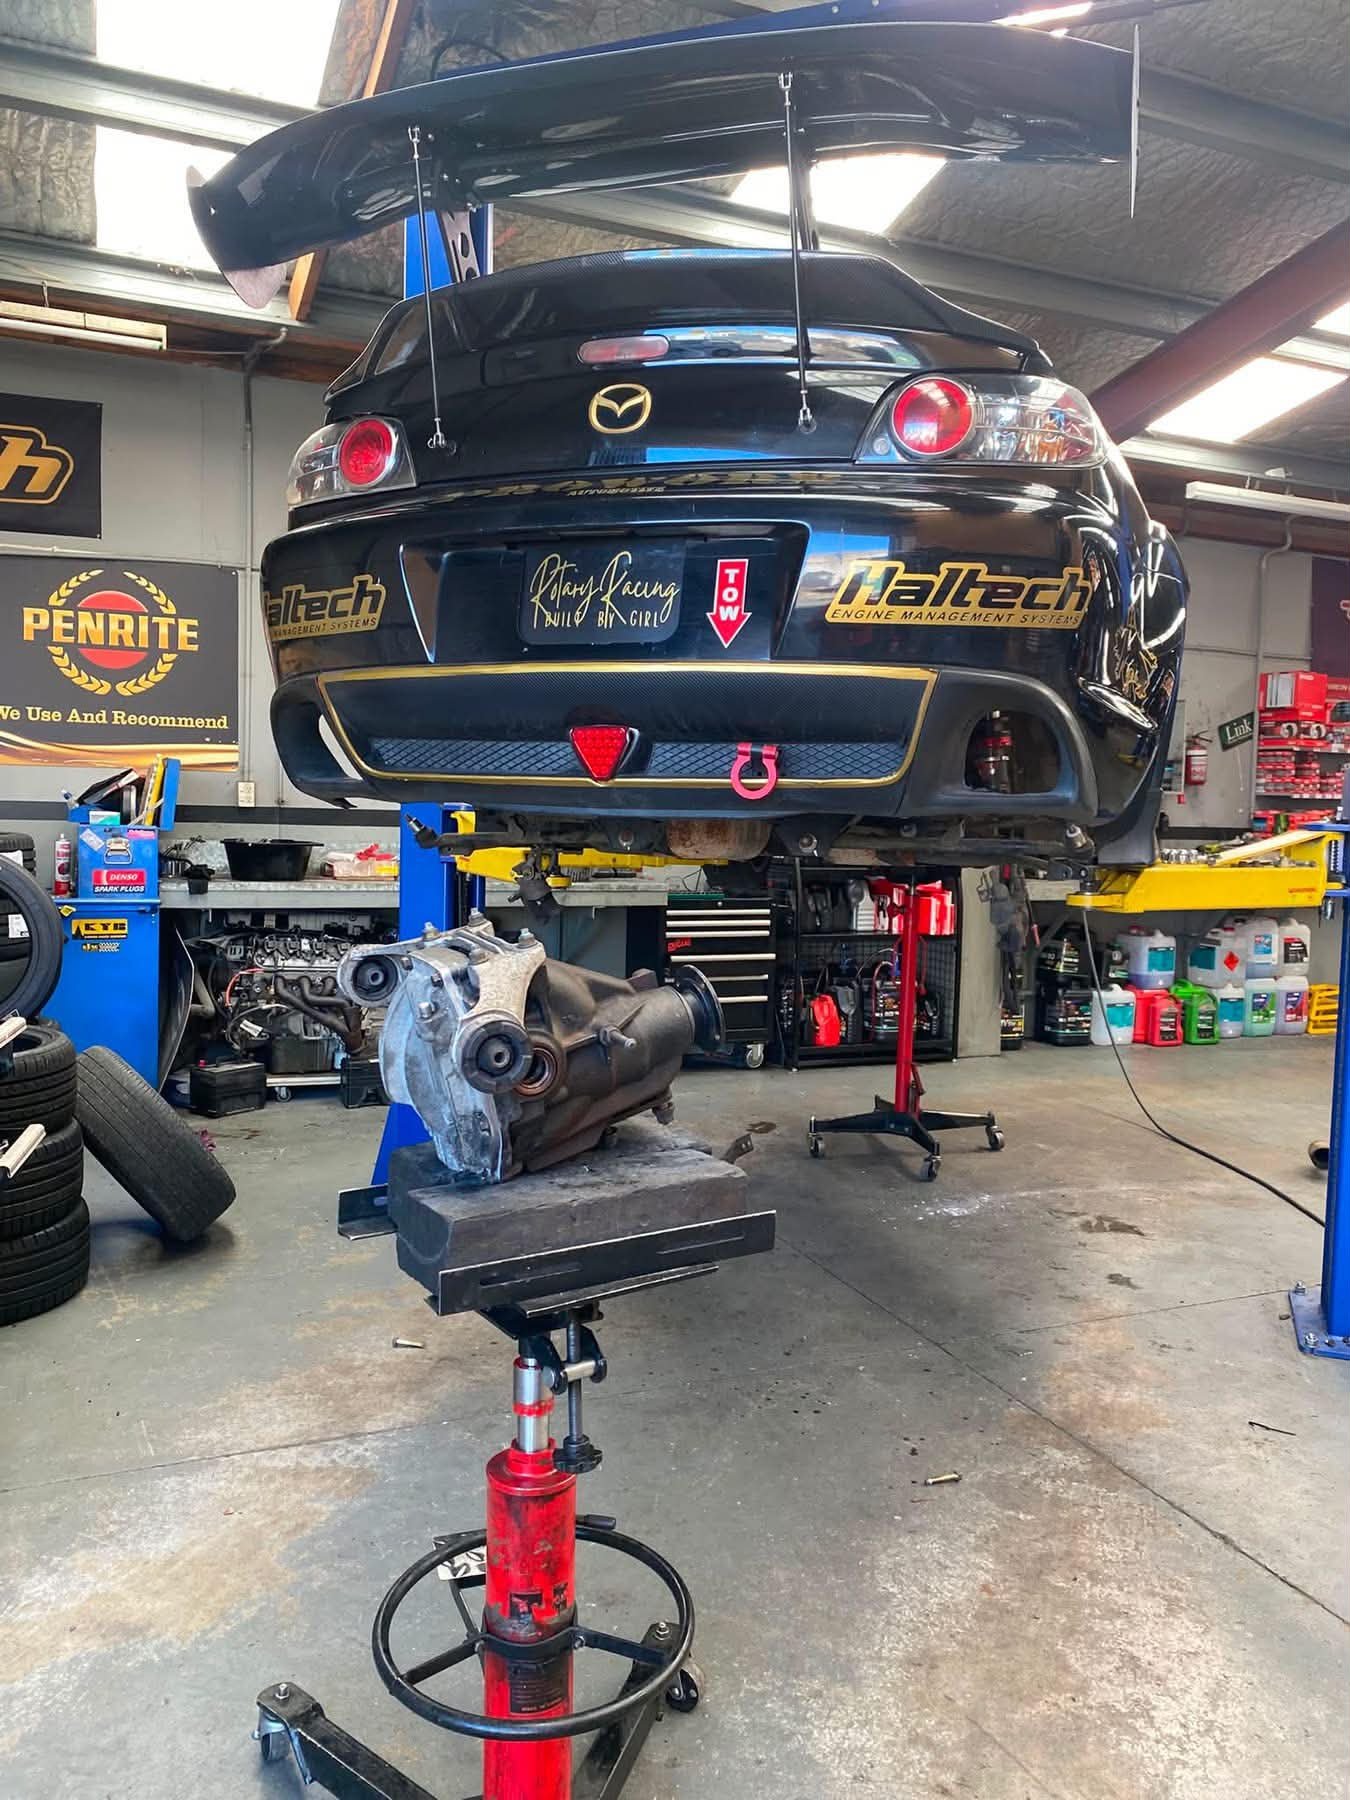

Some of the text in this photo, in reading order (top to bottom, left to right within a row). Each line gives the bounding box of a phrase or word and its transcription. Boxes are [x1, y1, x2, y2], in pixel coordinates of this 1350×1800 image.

[530, 550, 681, 629] Rotary Racing
[718, 568, 740, 621] TOW
[838, 565, 1088, 611] Haltech
[264, 577, 384, 627] altech
[330, 616, 377, 631] SYSTEMS
[630, 609, 659, 628] GIRL
[831, 608, 1082, 625] ENGINE MANAGEMENT SYSTEMS
[23, 606, 200, 652] PENRITE
[26, 706, 62, 722] Use
[67, 708, 108, 724] And
[111, 710, 229, 729] Recommend
[1226, 719, 1252, 740] Link
[110, 873, 138, 881] DENSO
[94, 885, 145, 893] SPARK PLUGS
